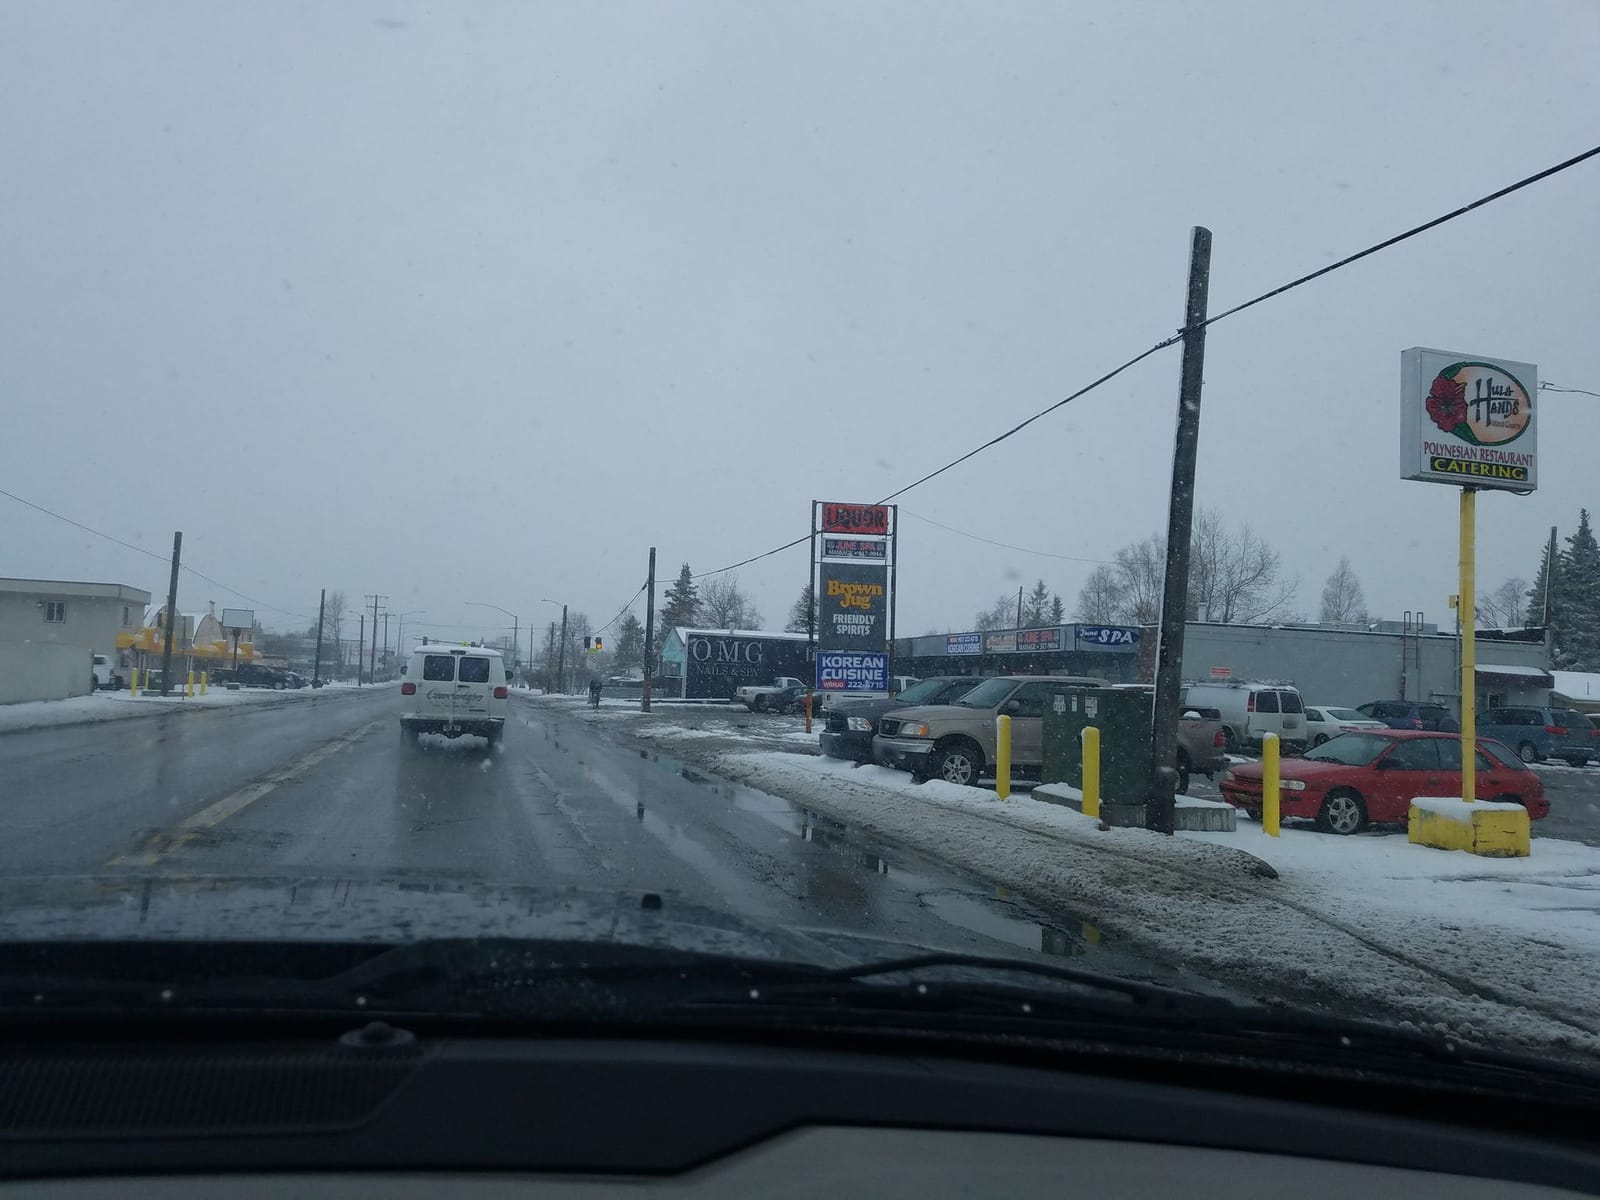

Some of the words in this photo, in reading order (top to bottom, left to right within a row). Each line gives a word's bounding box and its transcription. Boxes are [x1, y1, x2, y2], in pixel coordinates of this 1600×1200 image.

[1424, 441, 1477, 460] POLYNESIAN
[1480, 448, 1533, 468] RESTAURANT
[1434, 459, 1524, 480] CATERING
[826, 508, 885, 529] LIQUOR
[836, 541, 857, 550] JUNE
[860, 543, 876, 551] SPA
[827, 579, 882, 596] Brown
[840, 594, 871, 609] Jug
[833, 614, 875, 624] FRIENDLY
[836, 625, 870, 636] SPIRITS
[1079, 628, 1098, 637] June
[1098, 629, 1133, 643] SPA
[692, 639, 763, 664] OMG
[696, 664, 728, 675] NAILS
[822, 656, 883, 668] KOREAN
[822, 669, 883, 680] CUISINE
